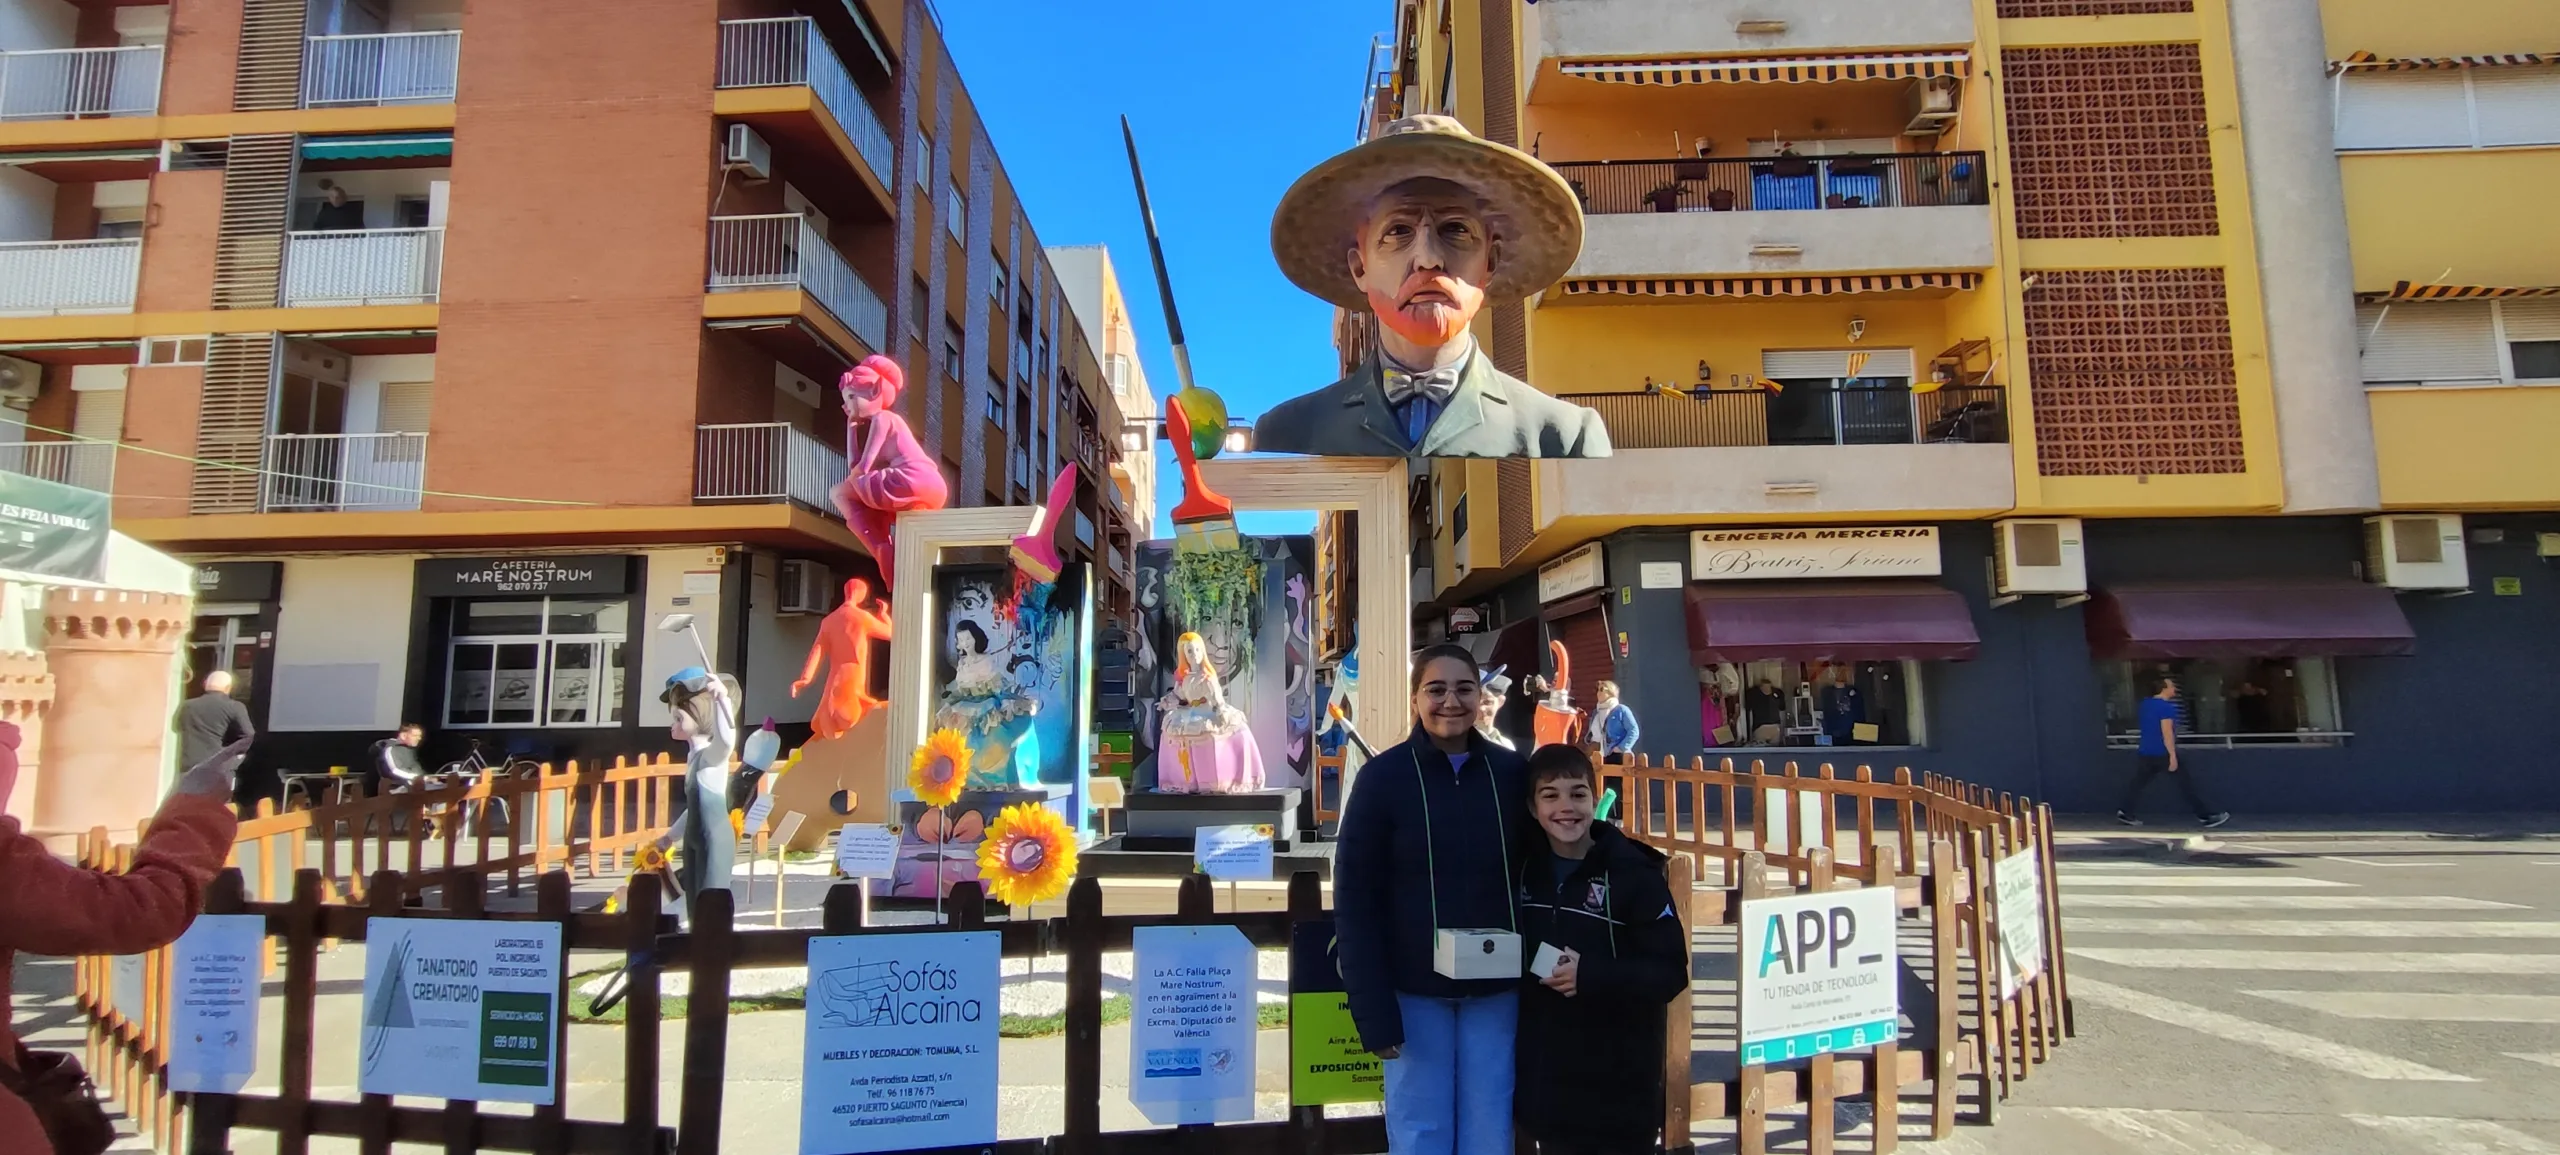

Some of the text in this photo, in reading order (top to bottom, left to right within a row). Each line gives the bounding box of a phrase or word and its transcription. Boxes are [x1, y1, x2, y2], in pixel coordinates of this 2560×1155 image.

[1702, 529, 1930, 542] LENCERIA MERCERIA
[492, 561, 557, 570] CAFETERIA
[1708, 548, 1817, 574] Beatriz
[456, 569, 593, 583] MARE NOSTRUM
[497, 582, 549, 591] 962 070 737
[1457, 624, 1474, 632] CGT
[416, 957, 478, 978] TANATORIO
[488, 968, 511, 977] PUERTO
[511, 968, 520, 977] DE
[1154, 966, 1232, 978] La A.C. Falla Plaça
[887, 960, 957, 992] Sofás
[1160, 980, 1225, 989] Mare Nostrum,
[1763, 971, 1878, 1000] TU TIENDA DE TECNOLOGÍA
[412, 982, 479, 1003] CREMATORIO
[1161, 994, 1173, 1002] en
[1174, 991, 1219, 1003] agraïment
[1229, 990, 1237, 999] la
[875, 992, 981, 1026] Alcaina
[1211, 1003, 1223, 1012] de
[1224, 1003, 1232, 1011] la
[524, 1011, 544, 1022] HORAS
[1147, 1015, 1237, 1027] Excma. Diputació de
[1173, 1029, 1211, 1038] València
[1328, 1036, 1346, 1045] Aire
[823, 1049, 860, 1061] MUEBLES
[862, 1049, 869, 1059] Y
[926, 1045, 963, 1056] TOMUMA,
[1310, 1060, 1370, 1073] EXPOSICIÓN
[1372, 1061, 1380, 1070] Y
[850, 1077, 869, 1087] Avda
[871, 1073, 909, 1085] Periodista
[939, 1072, 952, 1081] s/n
[867, 1086, 935, 1099] Telf. 96 118 76 75
[832, 1097, 968, 1114] 46520 PUERTO SAGUNTO (Valencia)
